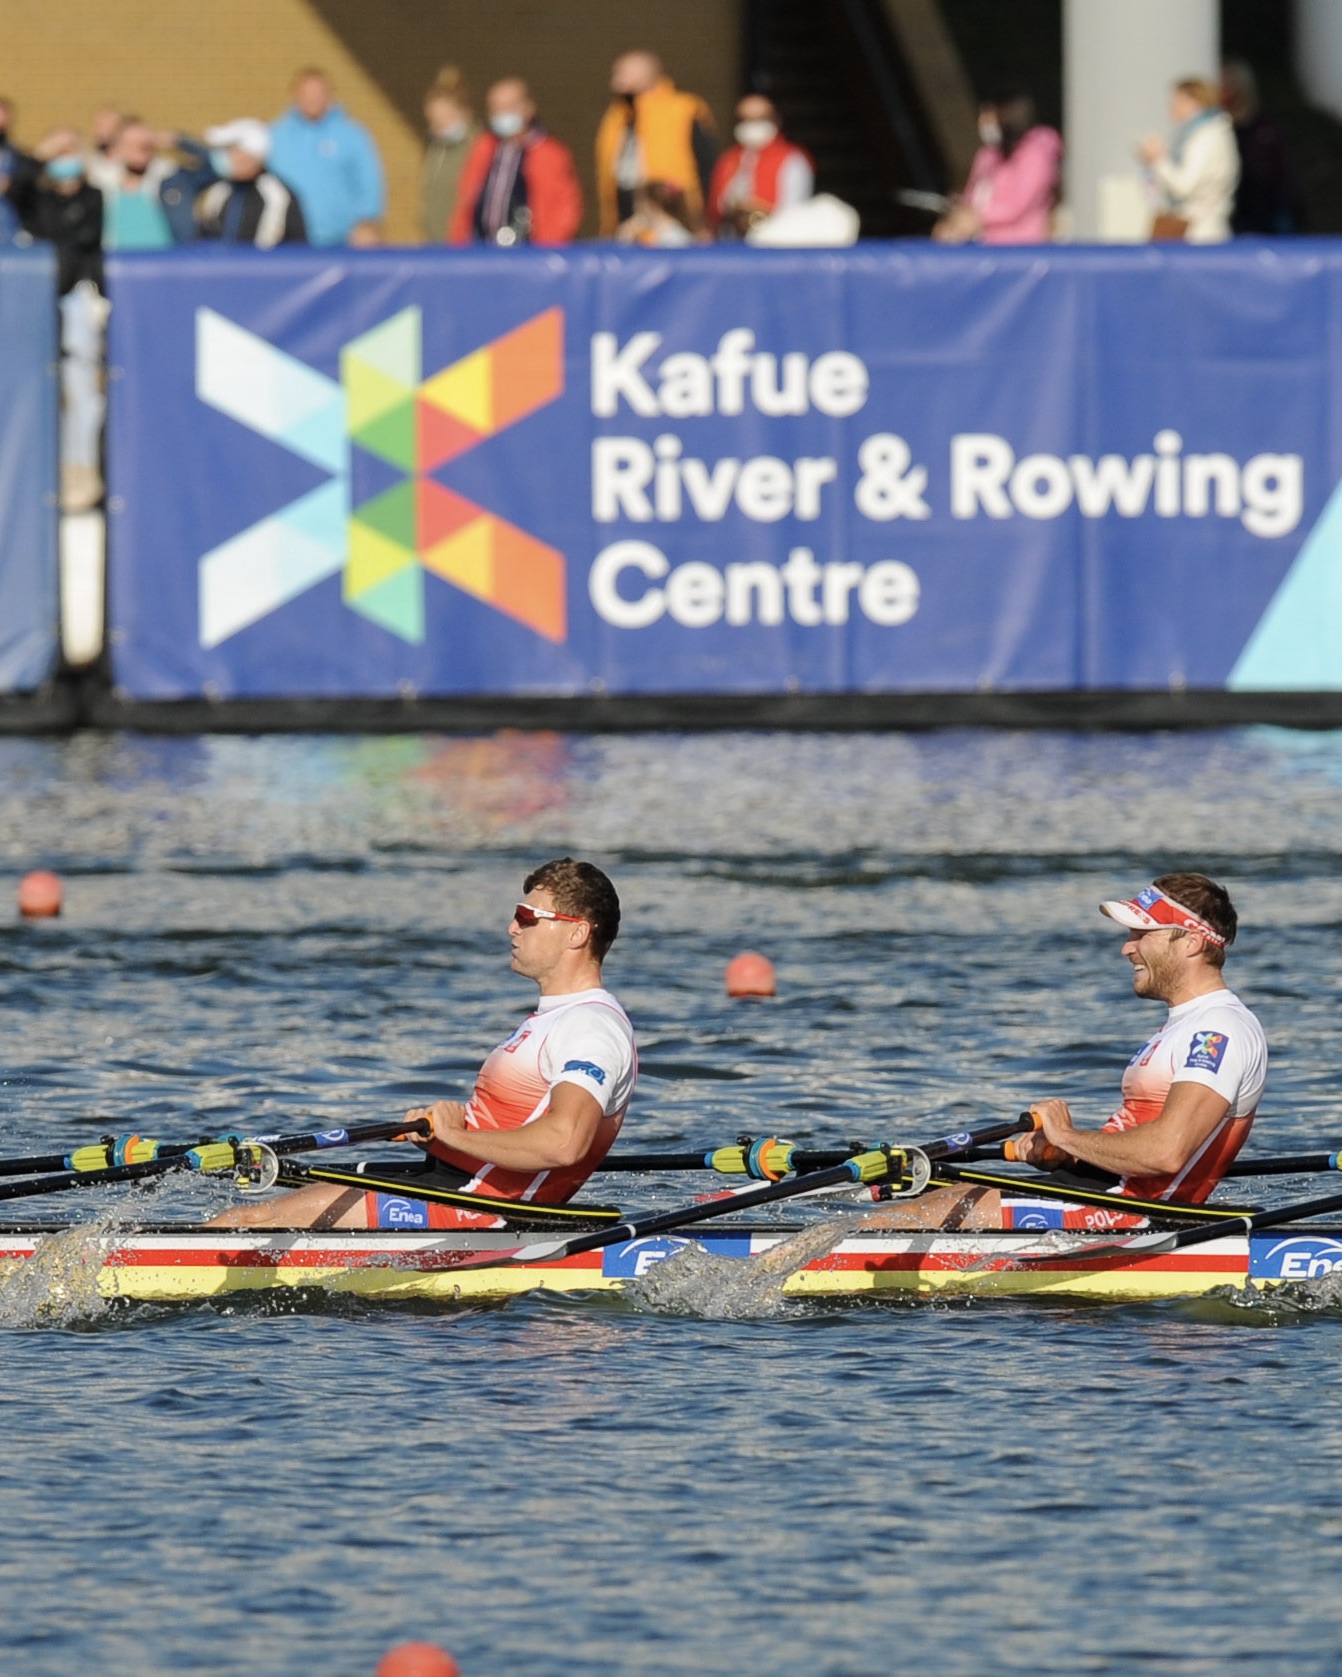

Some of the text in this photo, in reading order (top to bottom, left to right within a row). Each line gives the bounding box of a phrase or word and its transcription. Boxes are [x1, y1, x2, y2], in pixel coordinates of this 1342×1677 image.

[591, 328, 869, 418] Kafue
[591, 428, 1304, 538] River & Rowing
[588, 539, 921, 629] Centre
[389, 1207, 423, 1224] Enea
